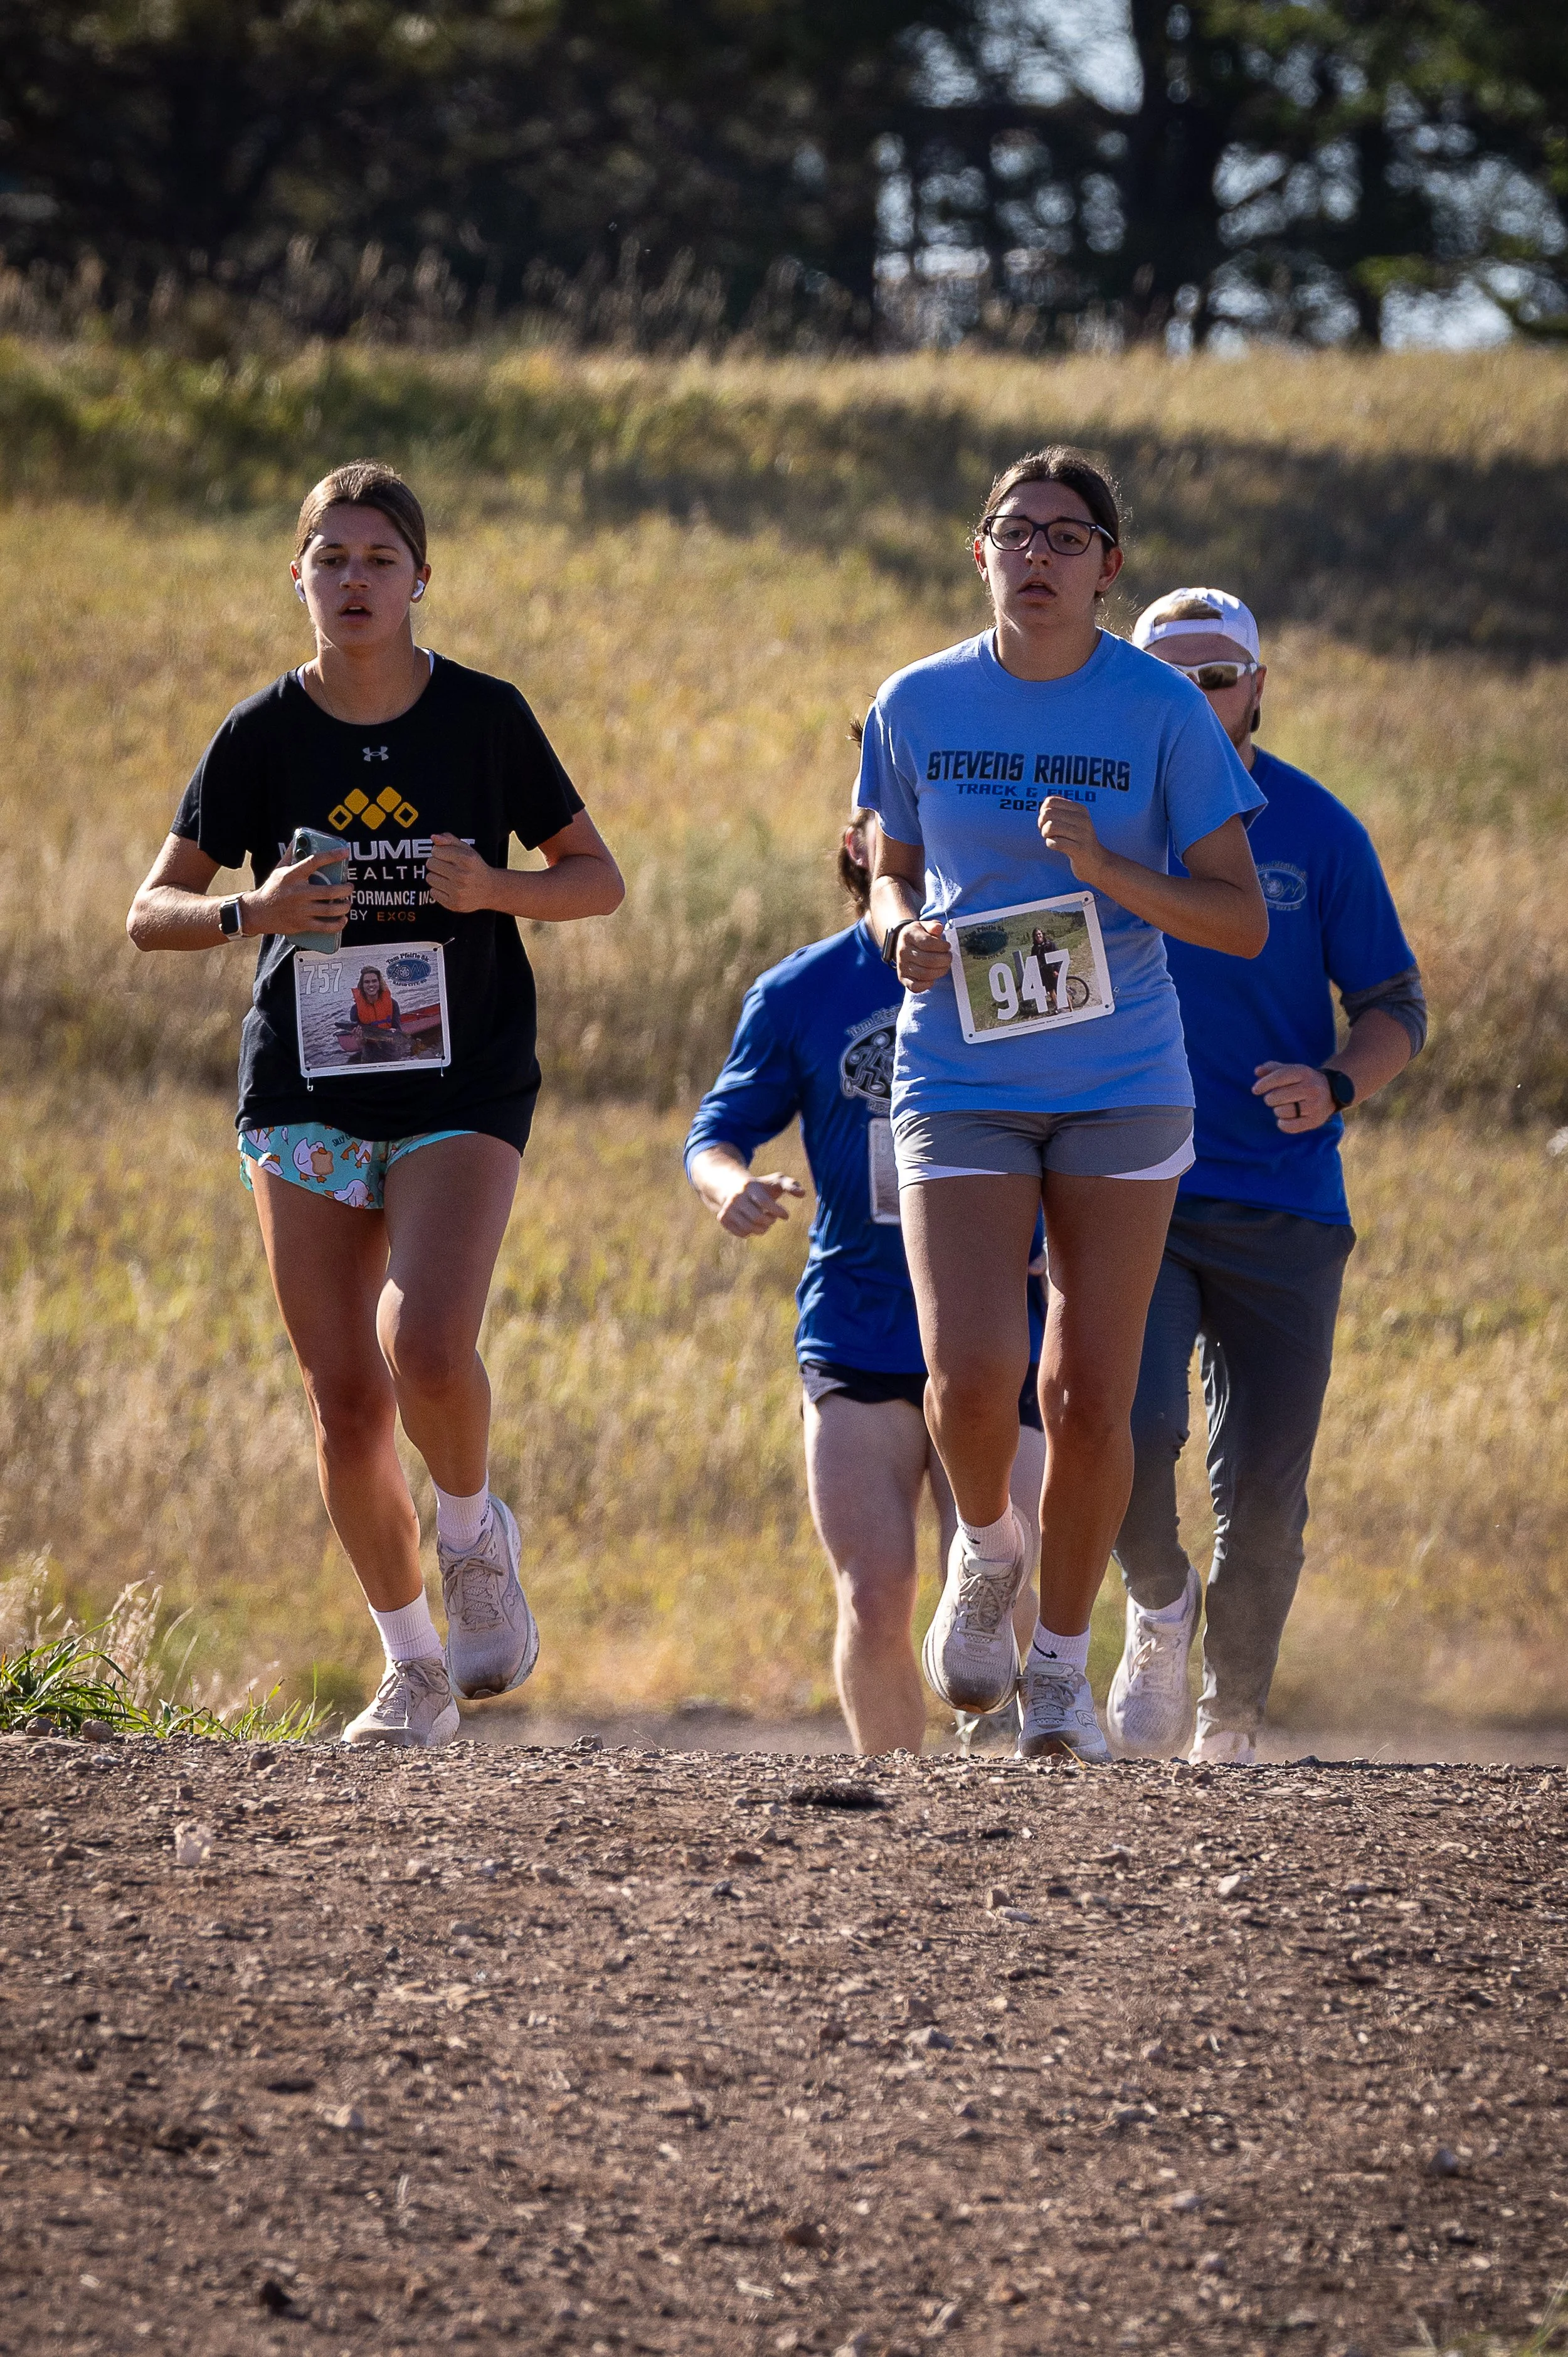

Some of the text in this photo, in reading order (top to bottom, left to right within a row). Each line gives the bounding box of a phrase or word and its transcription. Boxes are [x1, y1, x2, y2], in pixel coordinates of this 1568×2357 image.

[926, 750, 1131, 792] STEVENS RAIDERS
[956, 783, 1097, 802] TRACK & FIELD
[1000, 799, 1042, 812] 202
[347, 865, 425, 880] EALTH
[350, 890, 416, 906] FORMANCE
[350, 910, 416, 922] BY EXOS
[386, 955, 400, 964] Tom
[302, 962, 344, 996] 757
[988, 948, 1071, 1020] 947
